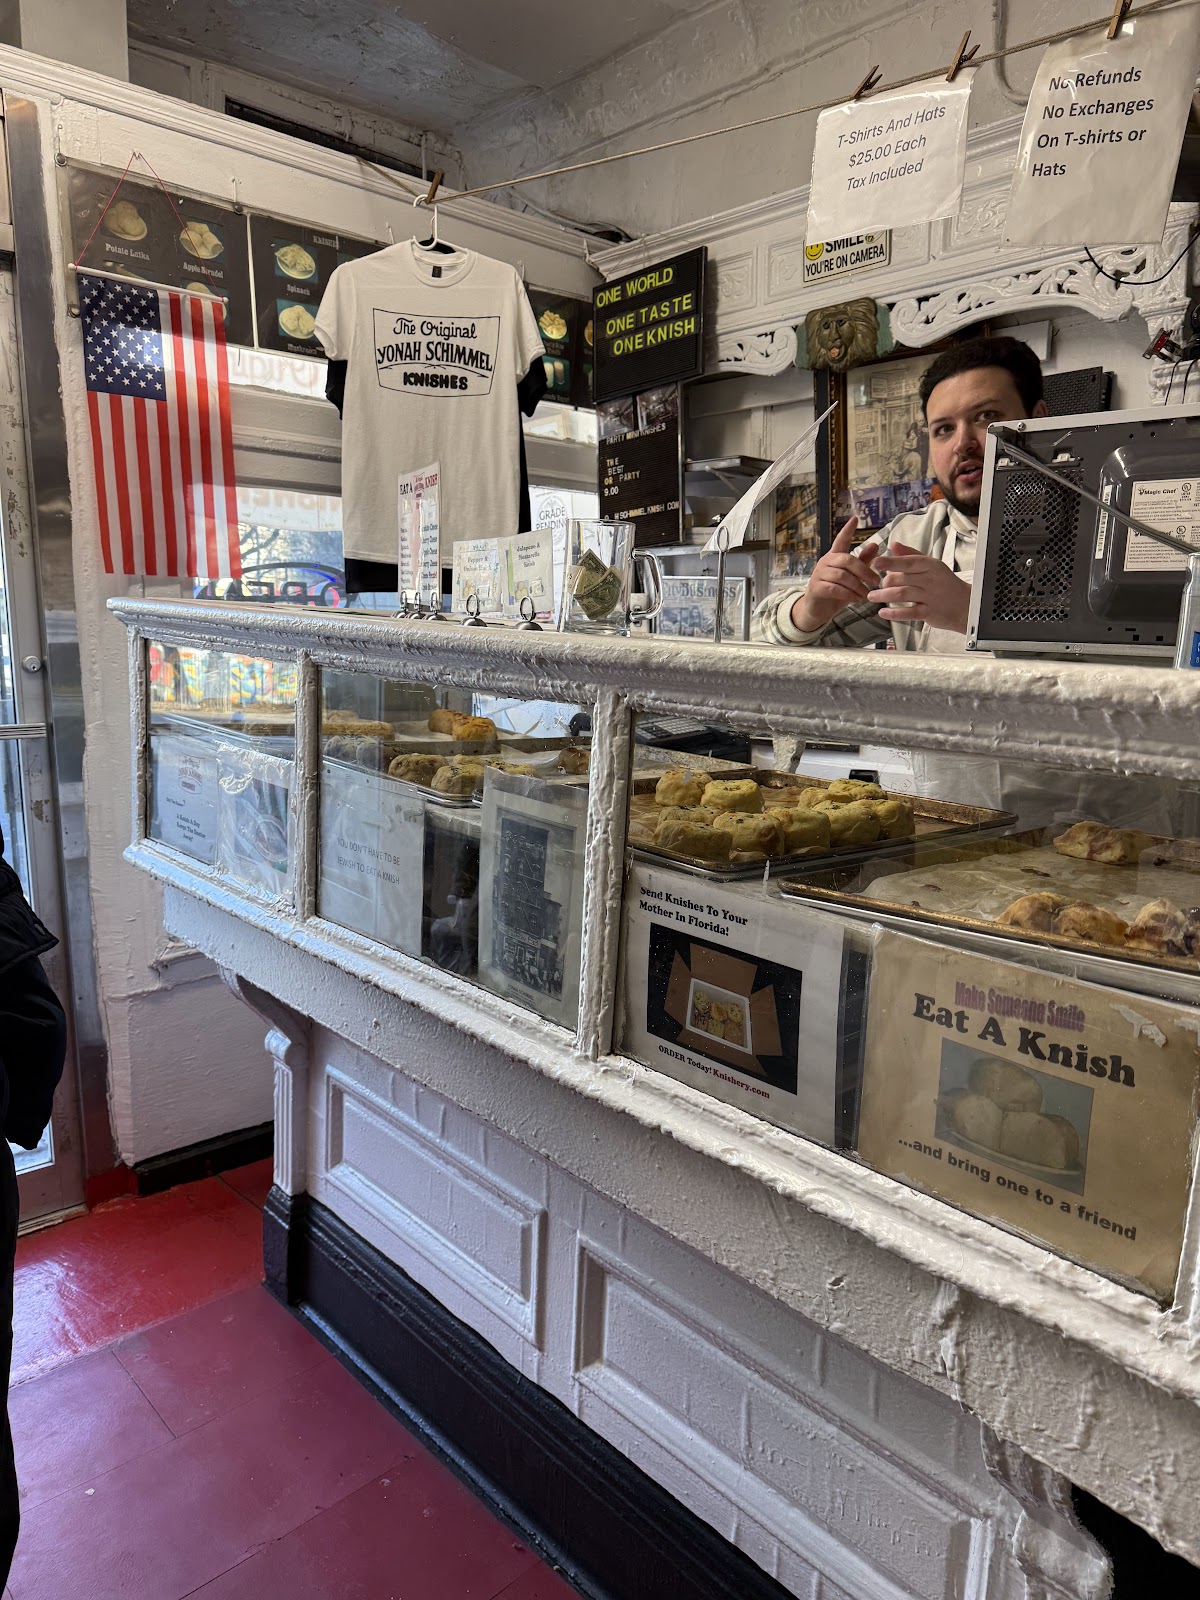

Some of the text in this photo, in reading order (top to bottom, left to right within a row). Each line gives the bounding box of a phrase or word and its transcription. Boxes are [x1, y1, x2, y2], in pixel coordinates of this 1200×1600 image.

[1049, 67, 1142, 92] No Refunds
[1042, 97, 1154, 120] No Exchanges
[838, 104, 946, 149] T-Shirts And Hats
[1037, 128, 1147, 149] On T-shirts or
[848, 134, 927, 169] $25.00 Each
[846, 158, 924, 191] Tax Included
[1031, 162, 1067, 178] Hats
[825, 234, 864, 254] SMILE
[182, 261, 201, 273] Apple
[806, 243, 885, 277] YOU'RE ON CAMERA
[286, 283, 311, 296] Spinach
[596, 267, 673, 308] ONE WORLD
[606, 293, 692, 335] ONE TASTE
[393, 317, 478, 341] The Original
[613, 317, 695, 355] ONE KNISH
[377, 340, 493, 372] YONAH SCHIMMEL
[403, 371, 469, 391] KNISHES
[606, 433, 626, 446] PARTY
[606, 457, 620, 467] THE
[608, 464, 624, 476] BEST
[400, 483, 410, 495] EAT
[425, 473, 438, 489] KNISH
[604, 470, 641, 486] OR PARTY
[604, 486, 619, 497] 9.00
[539, 506, 566, 521] GRADE
[523, 560, 536, 568] Knish
[662, 582, 737, 598] CityBusinss
[337, 837, 401, 866] YOU DON'T HAVE TO BE
[337, 855, 400, 885] JEWISH TO EAT A KNISH
[639, 900, 730, 937] Mother In Florida!
[640, 886, 749, 927] Send Knishes To Your
[954, 980, 1086, 1034] Make Someone Smile
[913, 992, 1136, 1088] Eat A Knish
[658, 1044, 771, 1099] ORDER Today! Knishery.com
[898, 1138, 1138, 1242] ...and bring one to a friend
